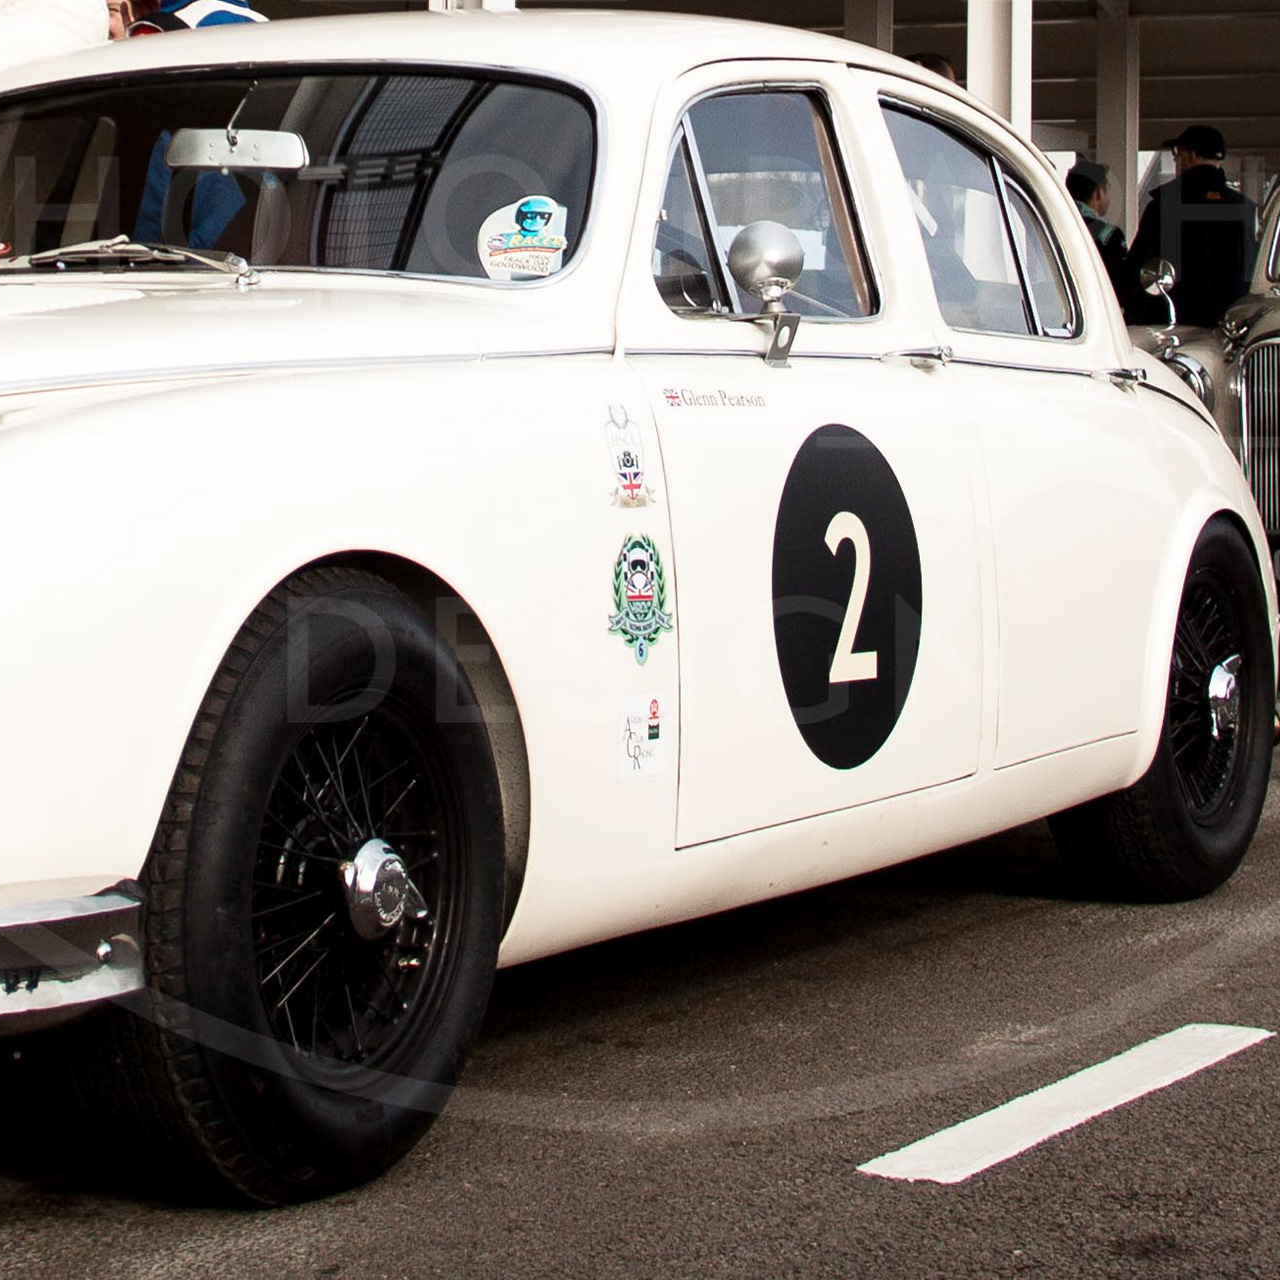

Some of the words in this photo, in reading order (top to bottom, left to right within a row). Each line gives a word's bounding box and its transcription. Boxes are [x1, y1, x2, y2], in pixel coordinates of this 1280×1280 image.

[490, 260, 549, 273] GOODWOOD
[681, 388, 718, 407] Glenn
[718, 389, 766, 408] Pearson
[823, 510, 878, 684] 2
